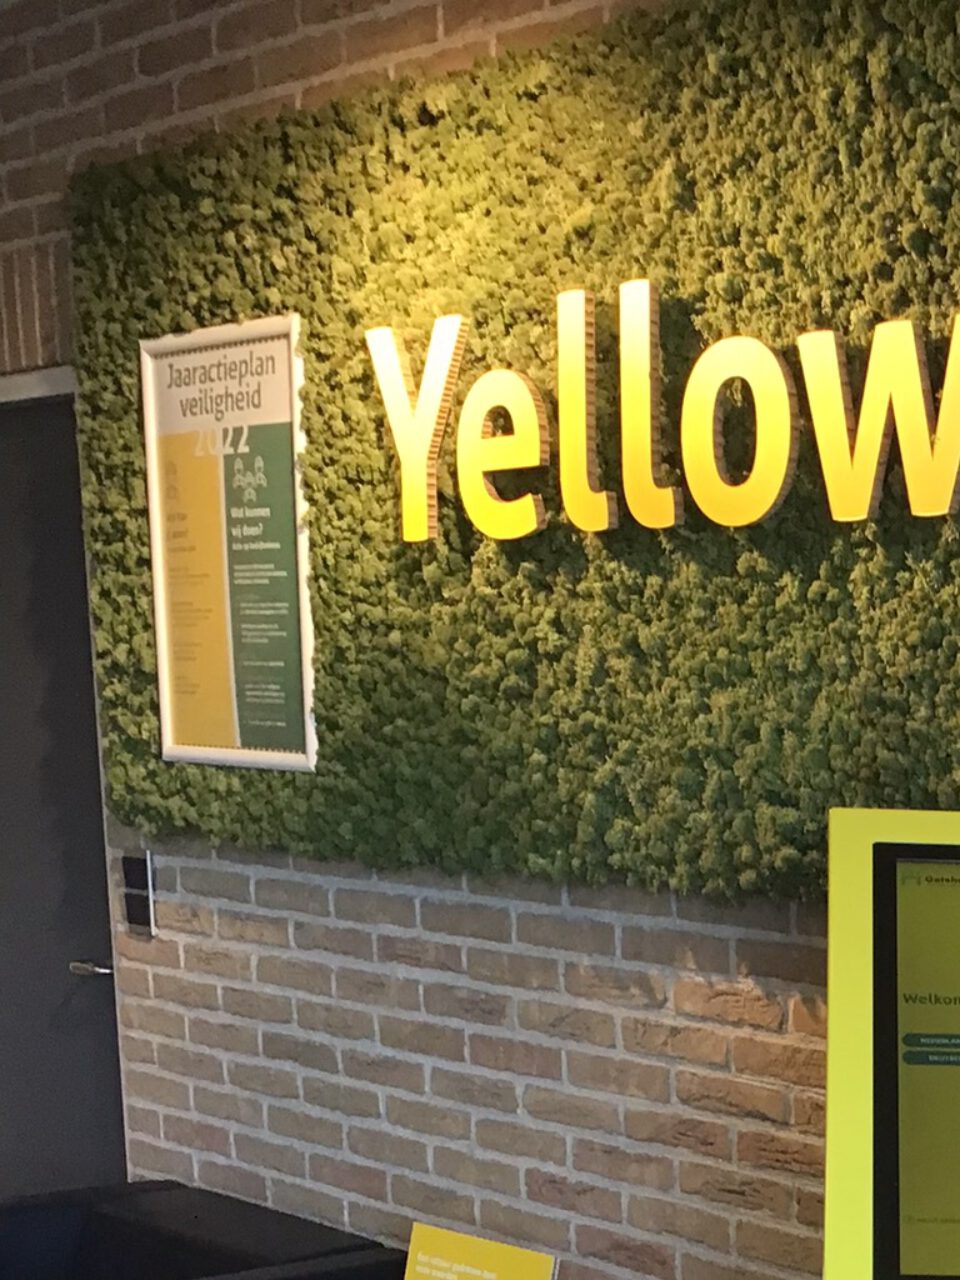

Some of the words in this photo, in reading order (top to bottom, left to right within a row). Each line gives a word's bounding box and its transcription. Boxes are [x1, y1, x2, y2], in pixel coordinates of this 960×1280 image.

[167, 351, 276, 389] Jaaractieplan
[179, 381, 262, 422] veiligheid
[194, 425, 251, 457] 2022
